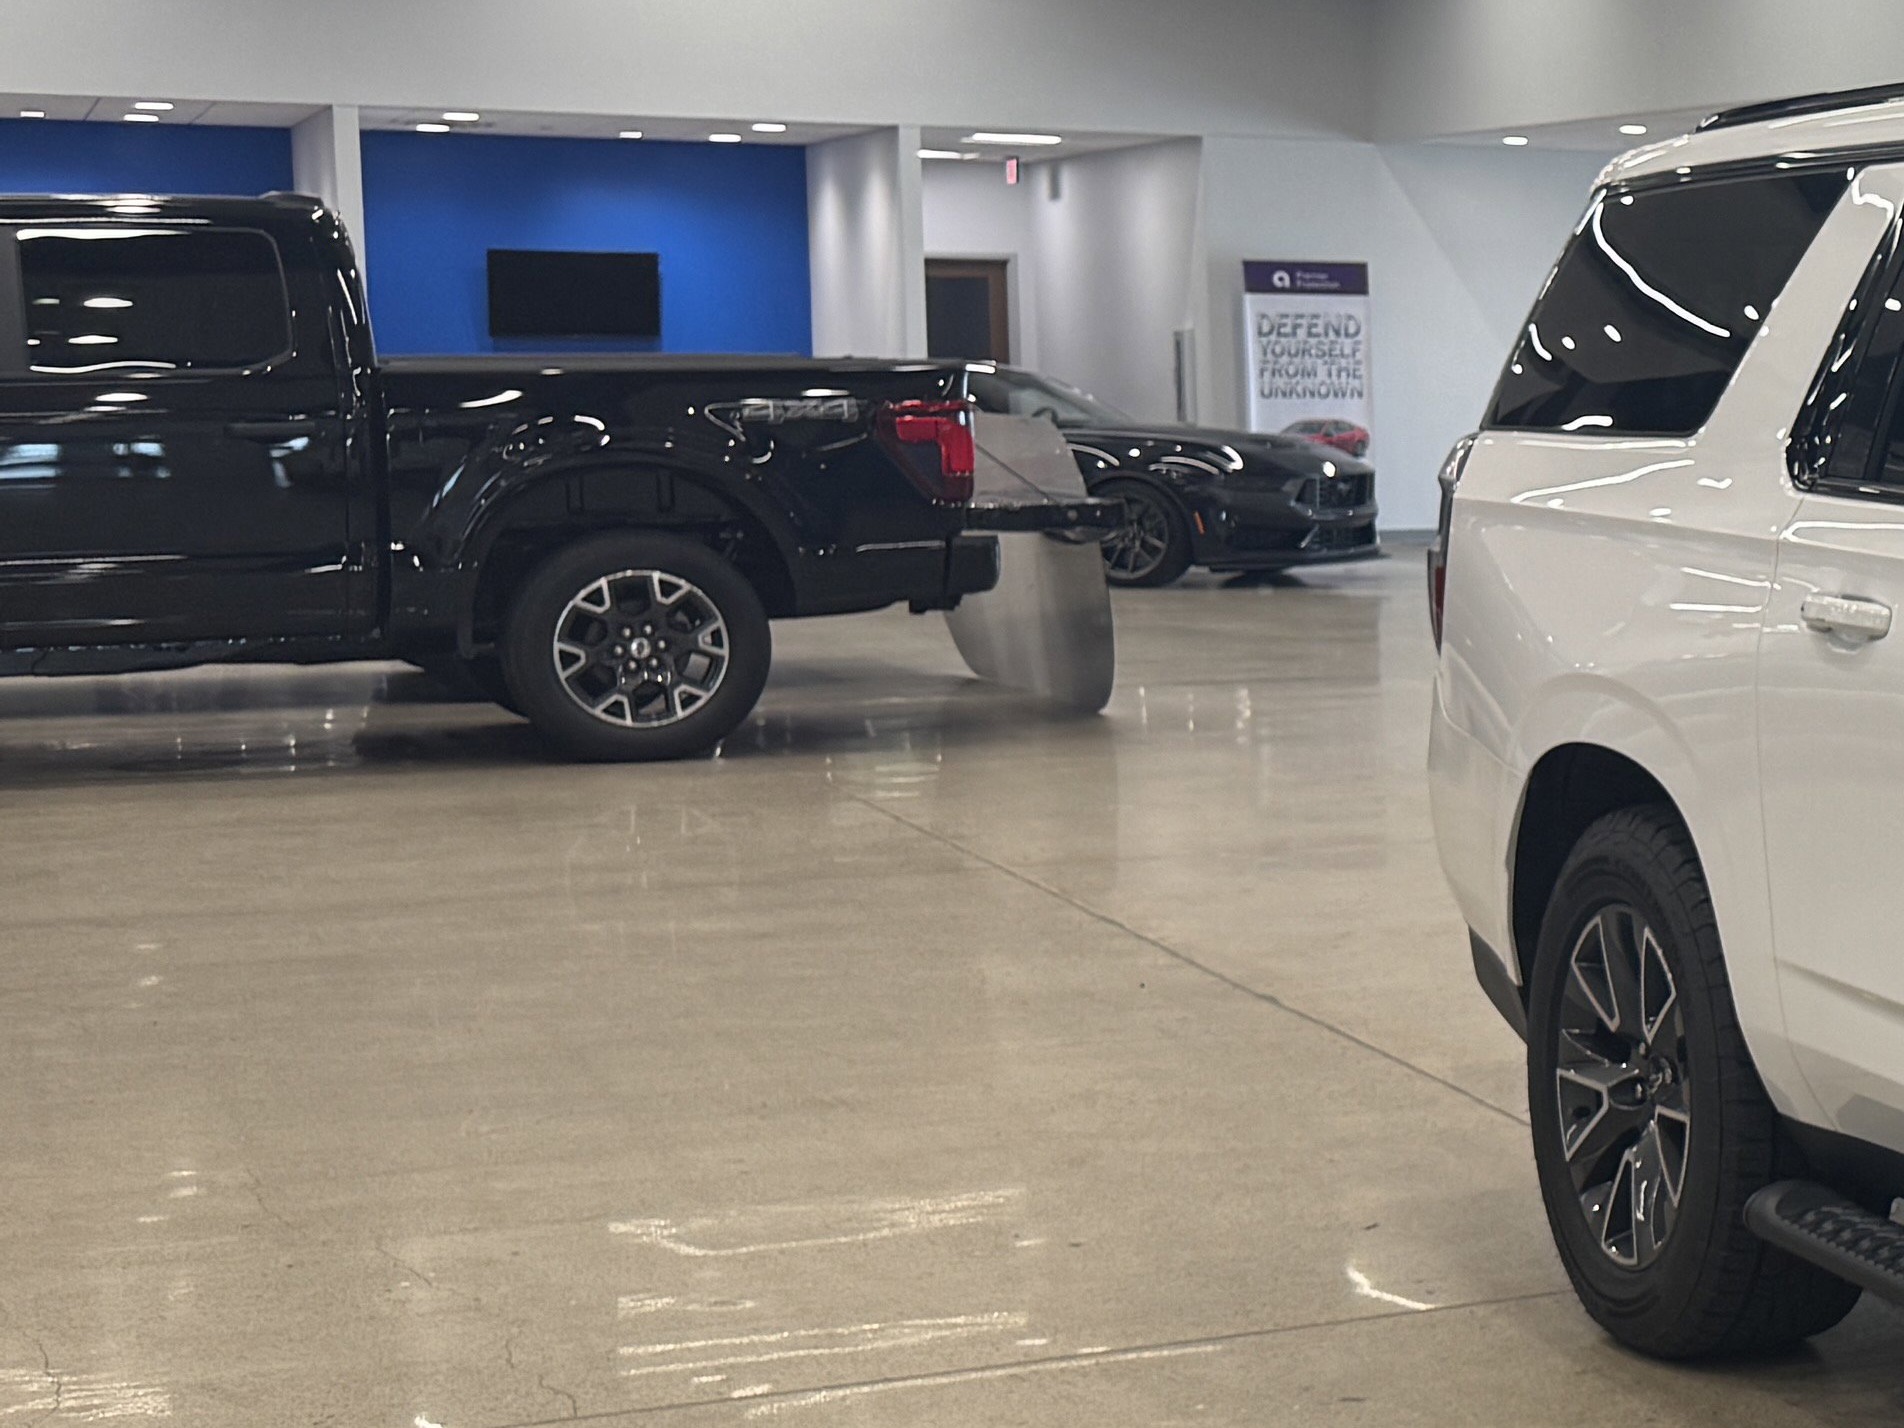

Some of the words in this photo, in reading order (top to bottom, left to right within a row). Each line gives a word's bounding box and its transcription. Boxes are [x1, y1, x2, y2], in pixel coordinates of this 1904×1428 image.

[1256, 312, 1362, 339] DEFEND
[1258, 340, 1363, 359] YOURSELF
[1259, 359, 1318, 380] FROM
[1322, 359, 1363, 380] THE
[1259, 381, 1364, 400] UNKNOWN
